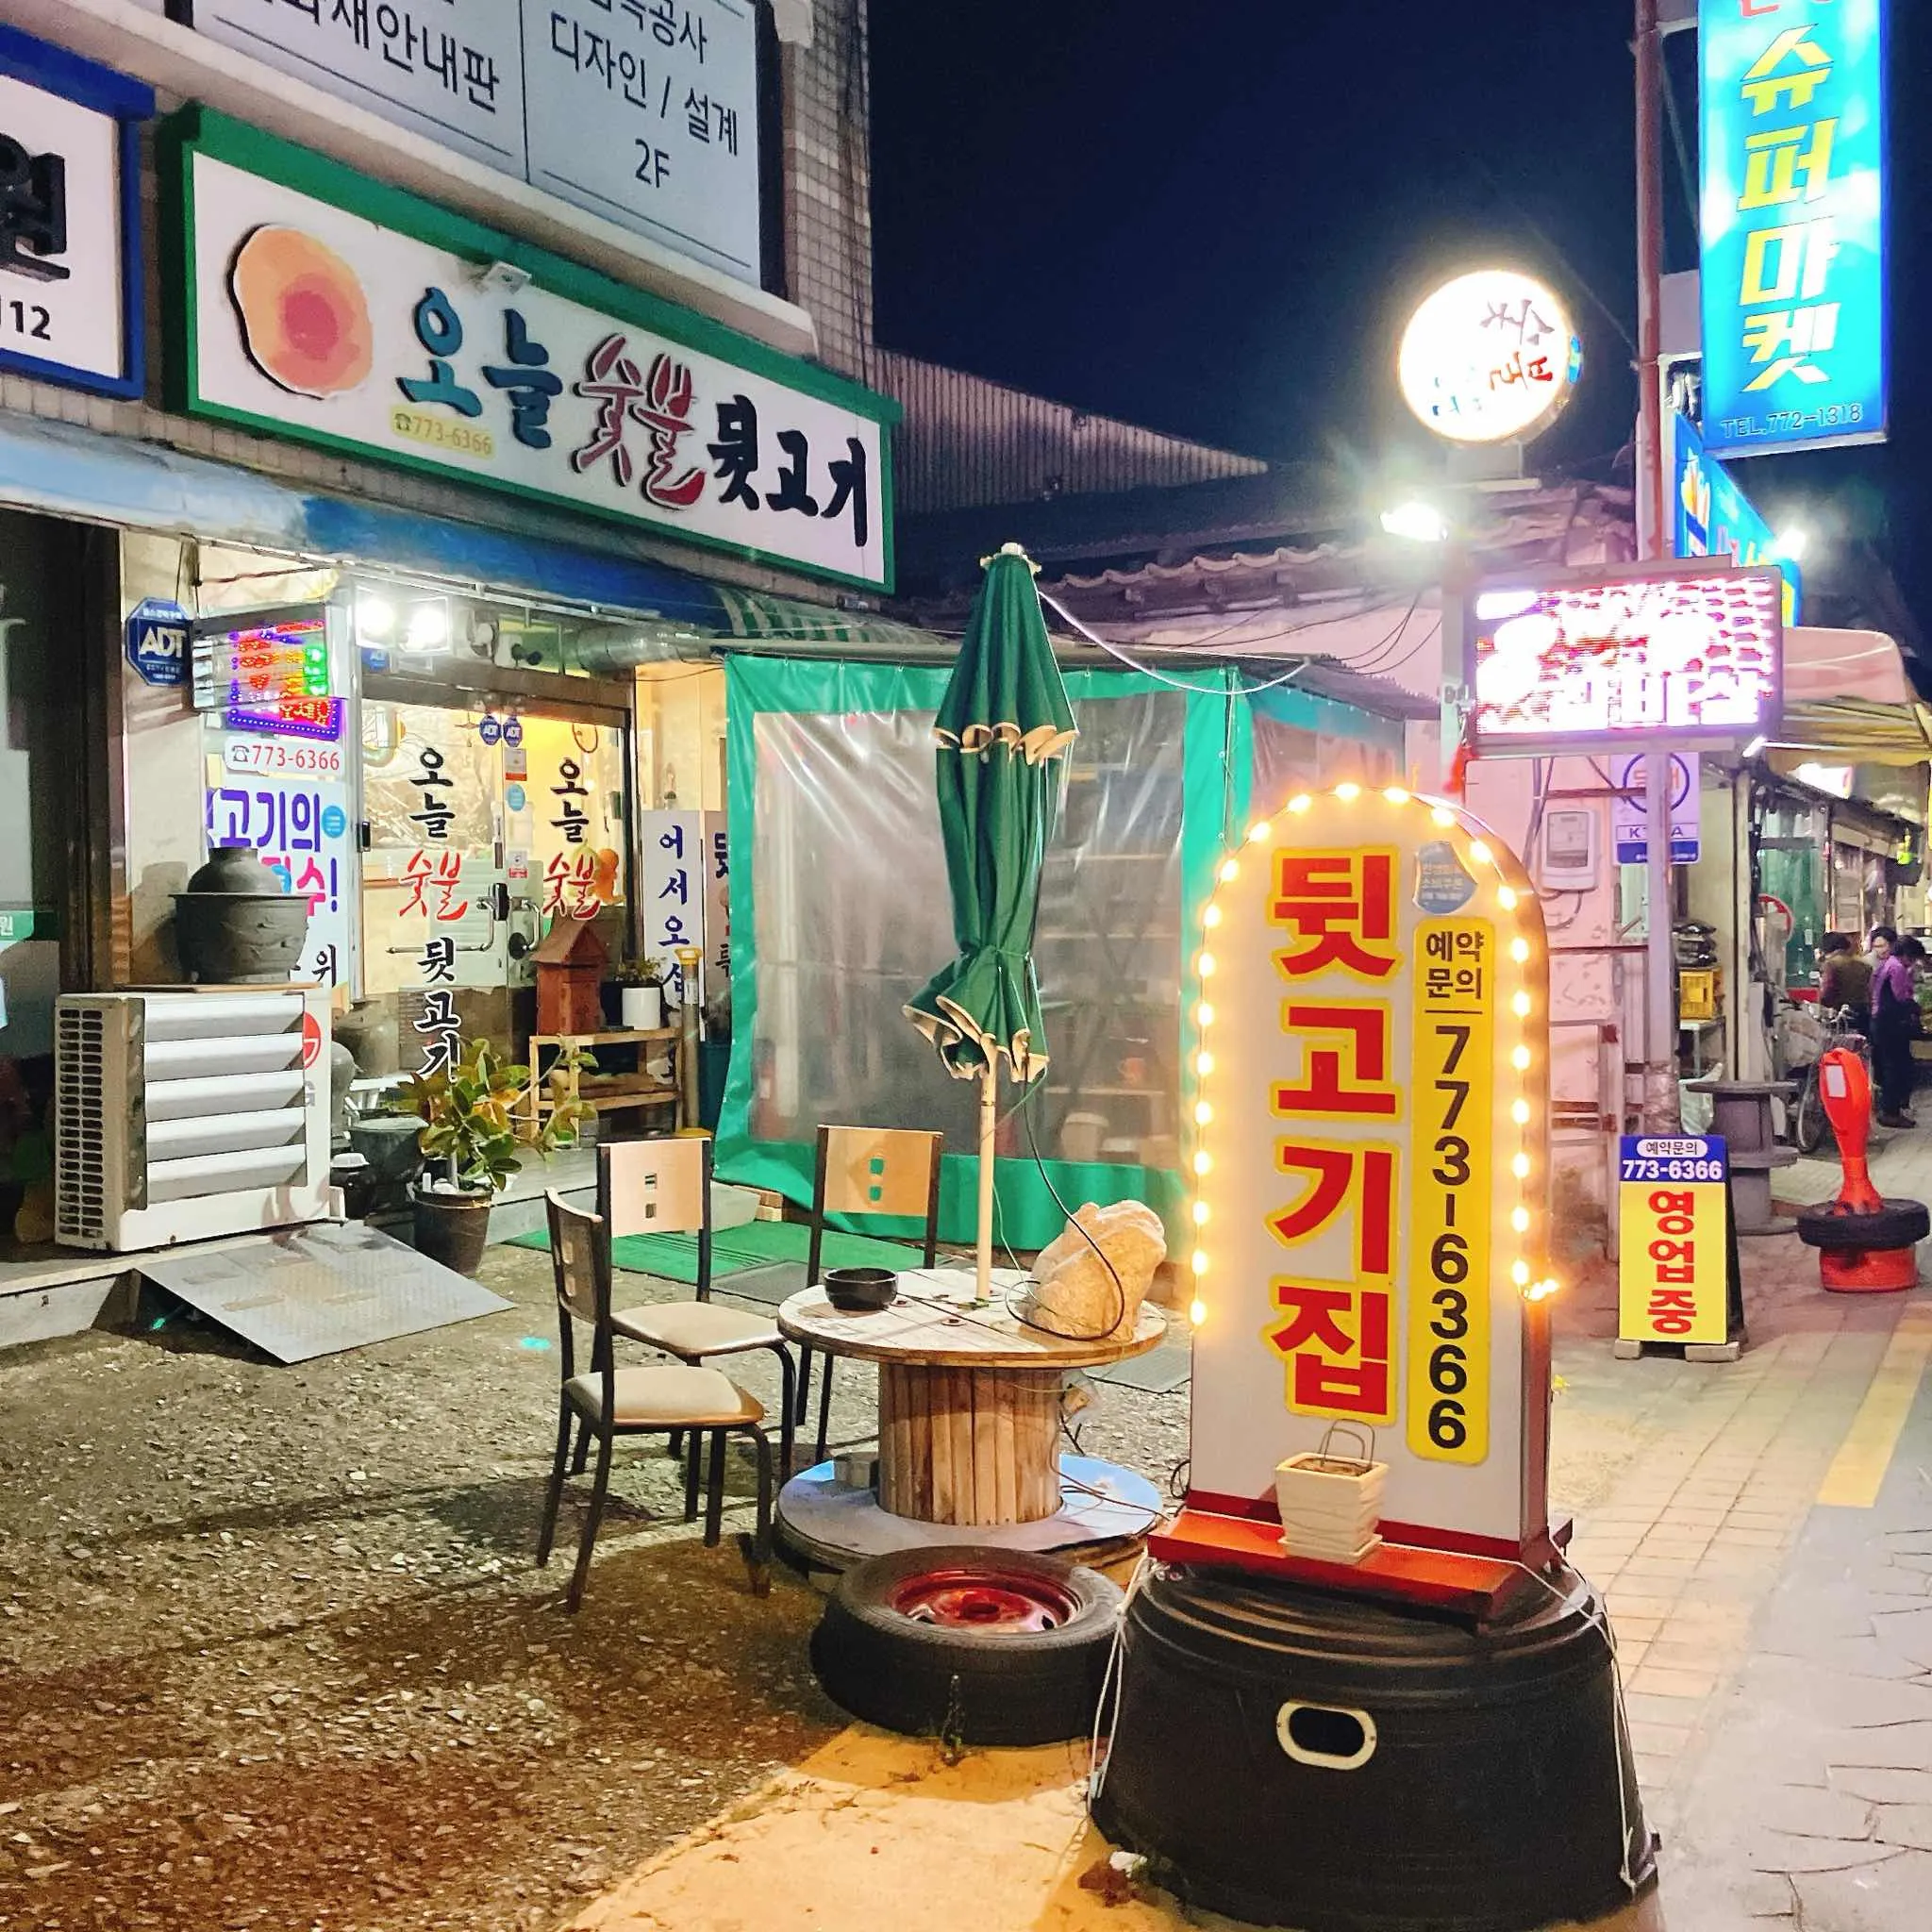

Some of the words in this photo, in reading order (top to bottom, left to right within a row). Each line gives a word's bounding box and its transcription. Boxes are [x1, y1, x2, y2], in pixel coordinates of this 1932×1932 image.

[265, 0, 499, 113] 재안내판
[551, 11, 647, 108] 디자인
[685, 88, 737, 157] 설계
[635, 139, 670, 188] 2F
[1737, 24, 1840, 392] 슈퍼마켓
[397, 287, 563, 449] 오늘
[571, 333, 707, 511] 숯불
[1721, 403, 1862, 439] TEL.772-1318
[412, 415, 492, 455] 773-6366
[138, 626, 187, 658] ADT
[252, 744, 340, 770] 773-6366
[206, 788, 321, 853] 고기의
[409, 747, 456, 838] 오늘
[550, 758, 590, 843] 오늘
[398, 849, 468, 921] 숯불
[543, 852, 601, 920] 숯불
[1425, 931, 1485, 962] 예약
[414, 937, 461, 1081] 뒷고기
[1425, 967, 1482, 1000] 문의
[1271, 855, 1396, 1416] 뒷고기집
[1623, 1159, 1723, 1180] 773-6366
[1645, 1141, 1699, 1156] 예약문의
[1427, 1024, 1472, 1450] 773-6366
[1647, 1191, 1697, 1335] 영업중
